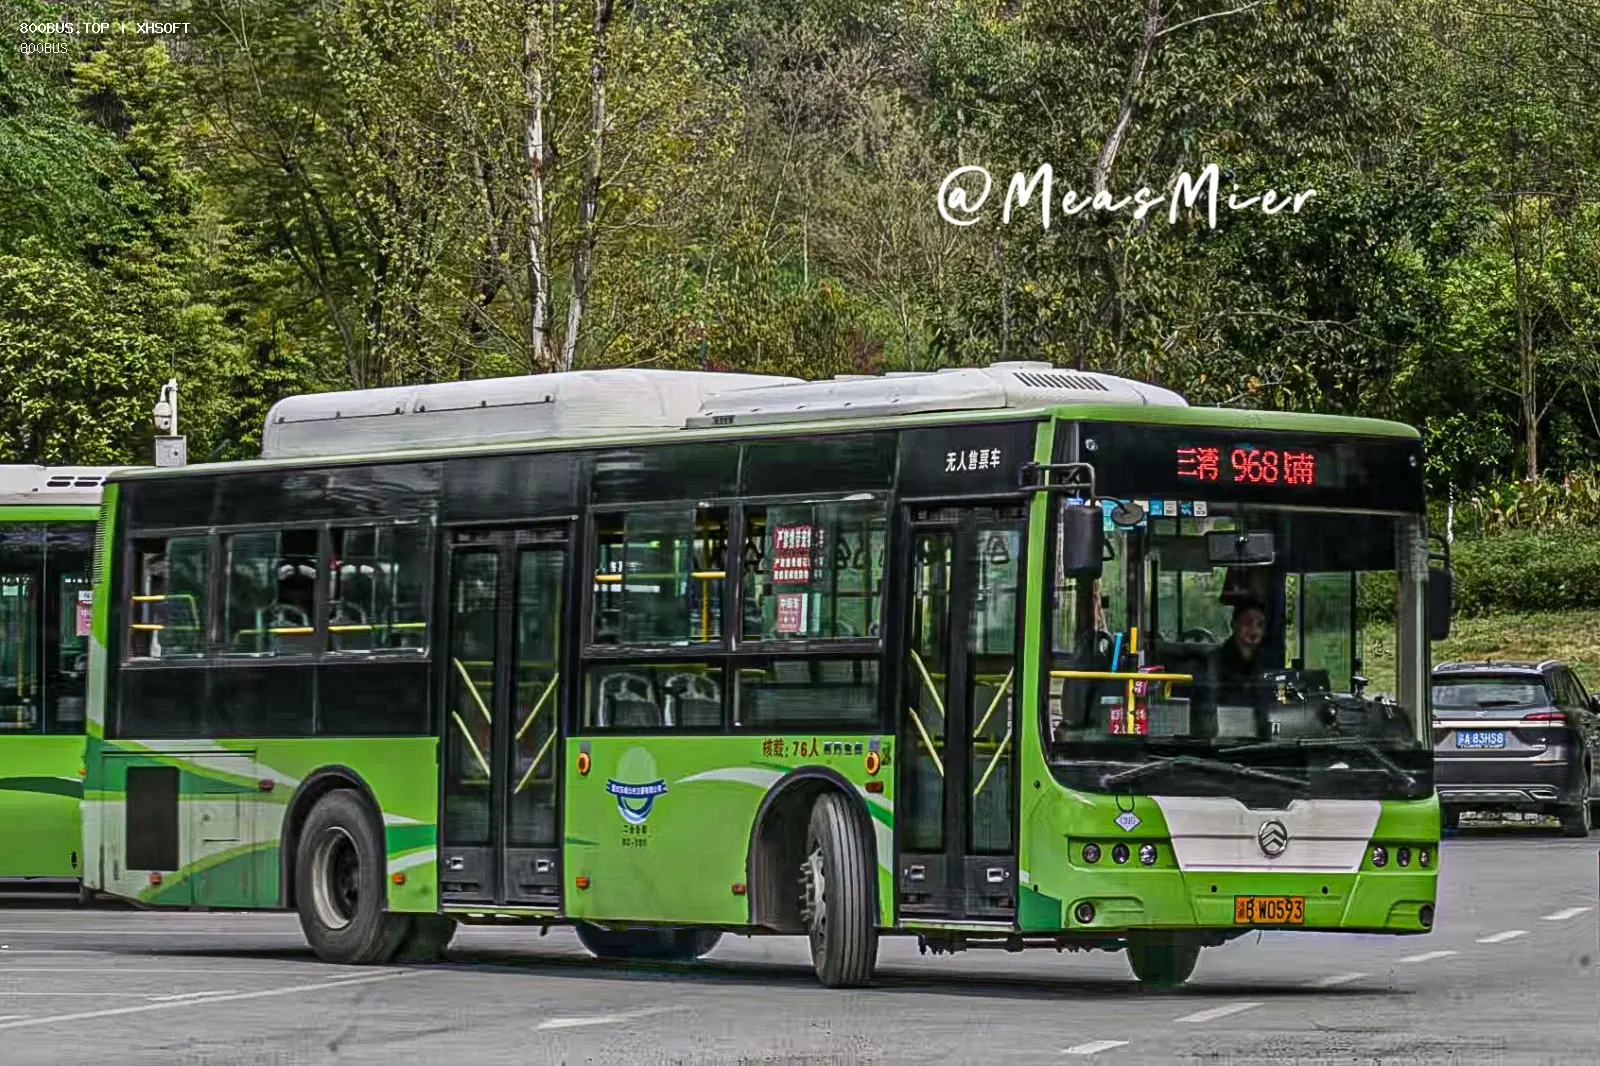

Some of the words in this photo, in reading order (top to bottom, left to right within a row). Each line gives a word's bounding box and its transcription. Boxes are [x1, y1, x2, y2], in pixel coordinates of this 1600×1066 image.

[945, 447, 1001, 472] 无人售票车
[1231, 449, 1278, 483] 968
